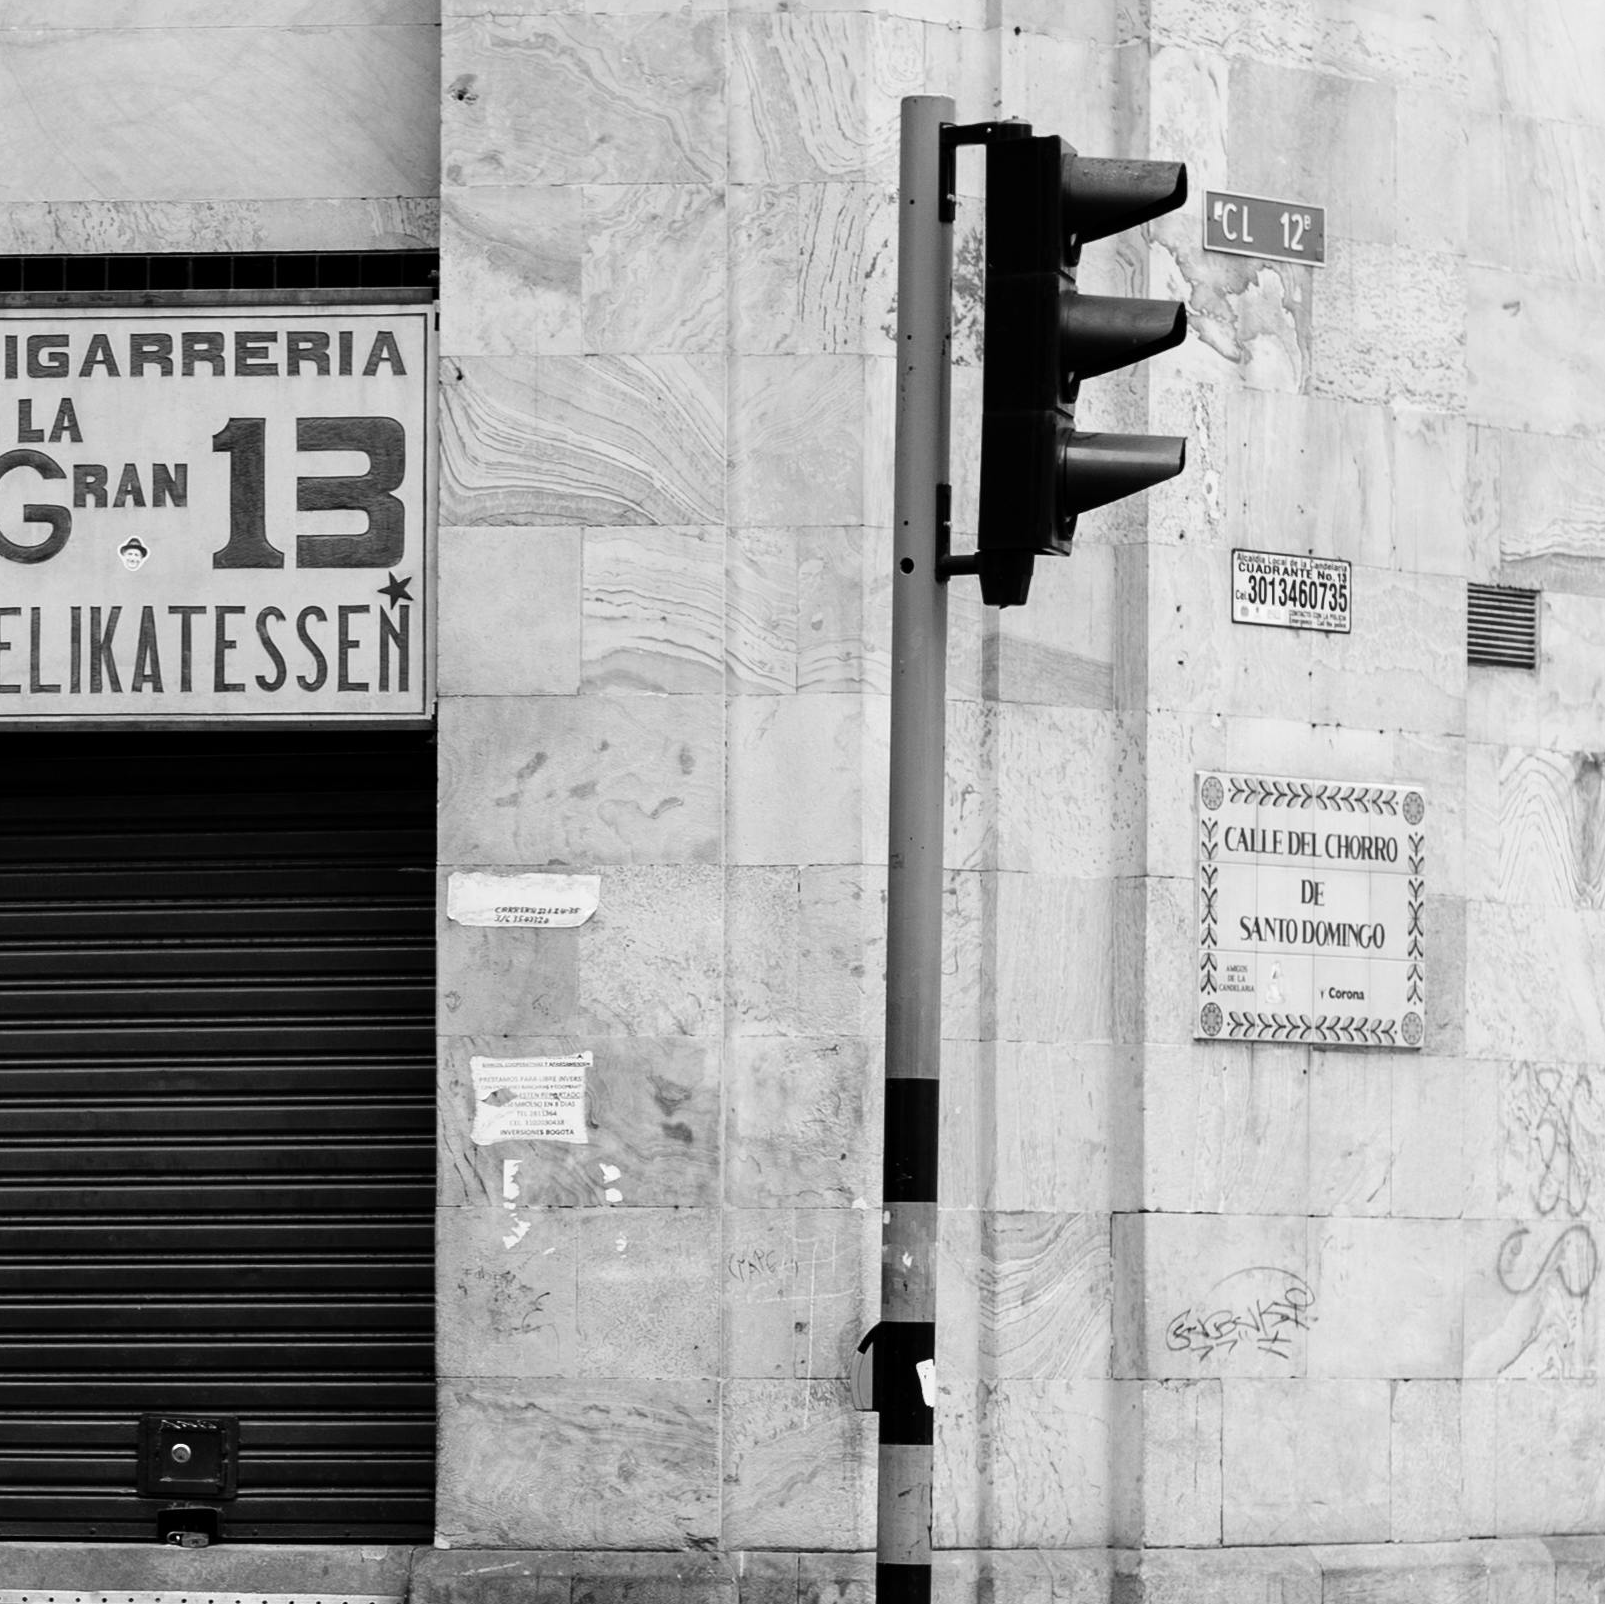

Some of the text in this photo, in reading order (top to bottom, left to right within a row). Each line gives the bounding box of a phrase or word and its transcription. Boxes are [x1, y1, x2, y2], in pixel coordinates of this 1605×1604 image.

[1222, 202, 1254, 243] CL
[17, 397, 84, 444] LA
[211, 416, 407, 570] 13
[1238, 562, 1313, 580] CUADRANTE
[1248, 575, 1348, 612] 3013460735
[1224, 826, 1398, 863] CALLE DEL CHORRO
[1300, 879, 1325, 906] DE
[1239, 916, 1385, 950] SANTO DOMINGO
[1328, 986, 1365, 1000] Corona
[545, 1128, 575, 1136] BOGOTA
